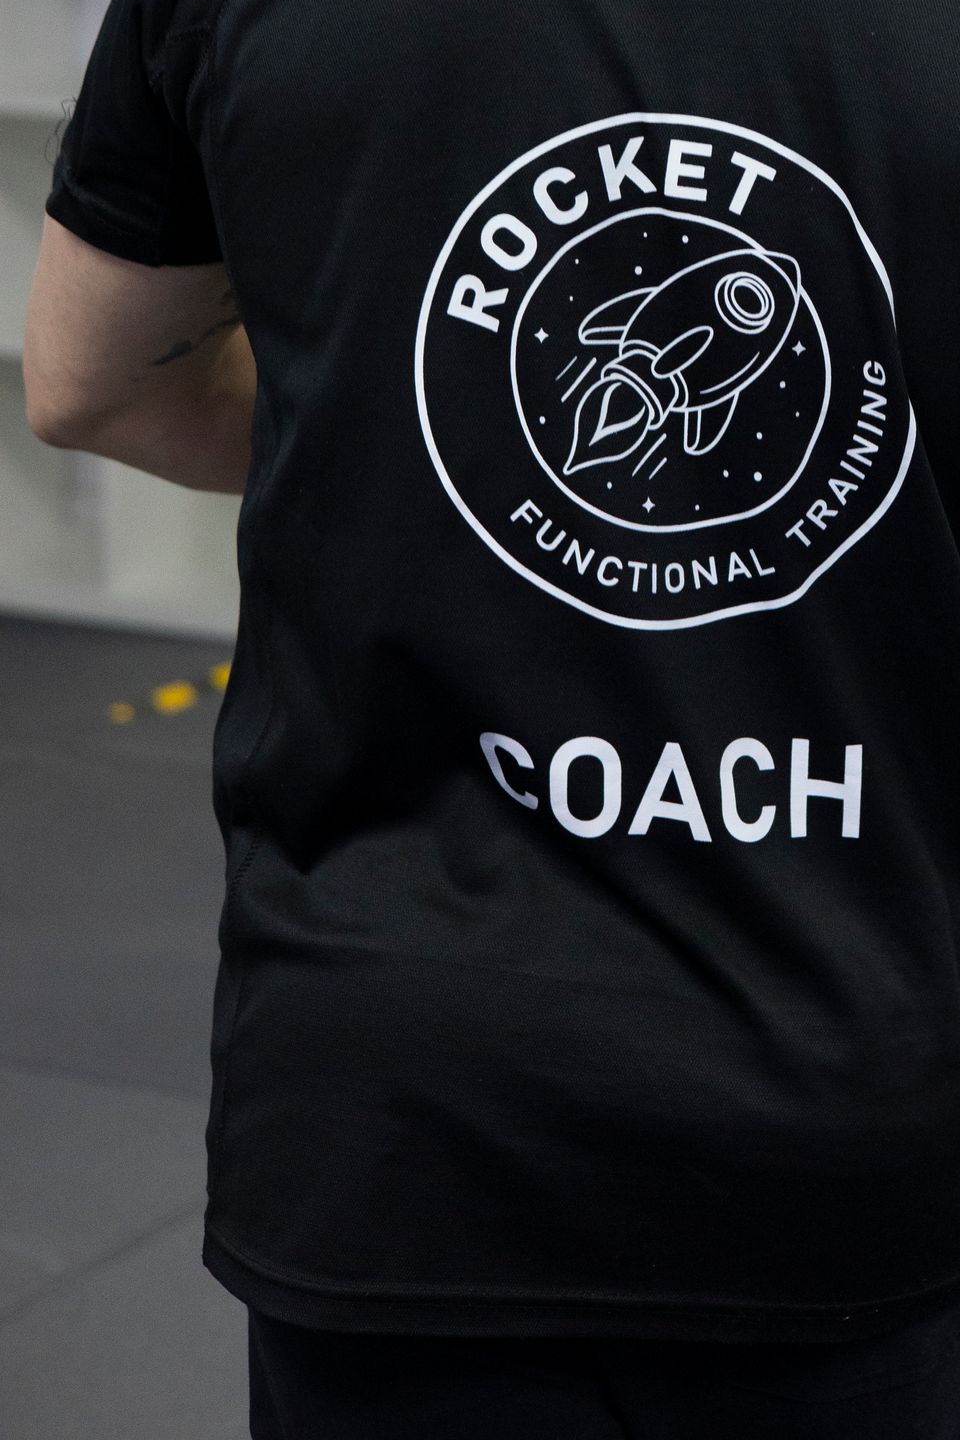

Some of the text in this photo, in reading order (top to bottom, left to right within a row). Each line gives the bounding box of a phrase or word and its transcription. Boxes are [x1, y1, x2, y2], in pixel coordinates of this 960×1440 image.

[446, 135, 777, 333] ROCKET
[510, 360, 888, 594] FUNCTIONAL TRAINING
[479, 732, 863, 843] COACH
